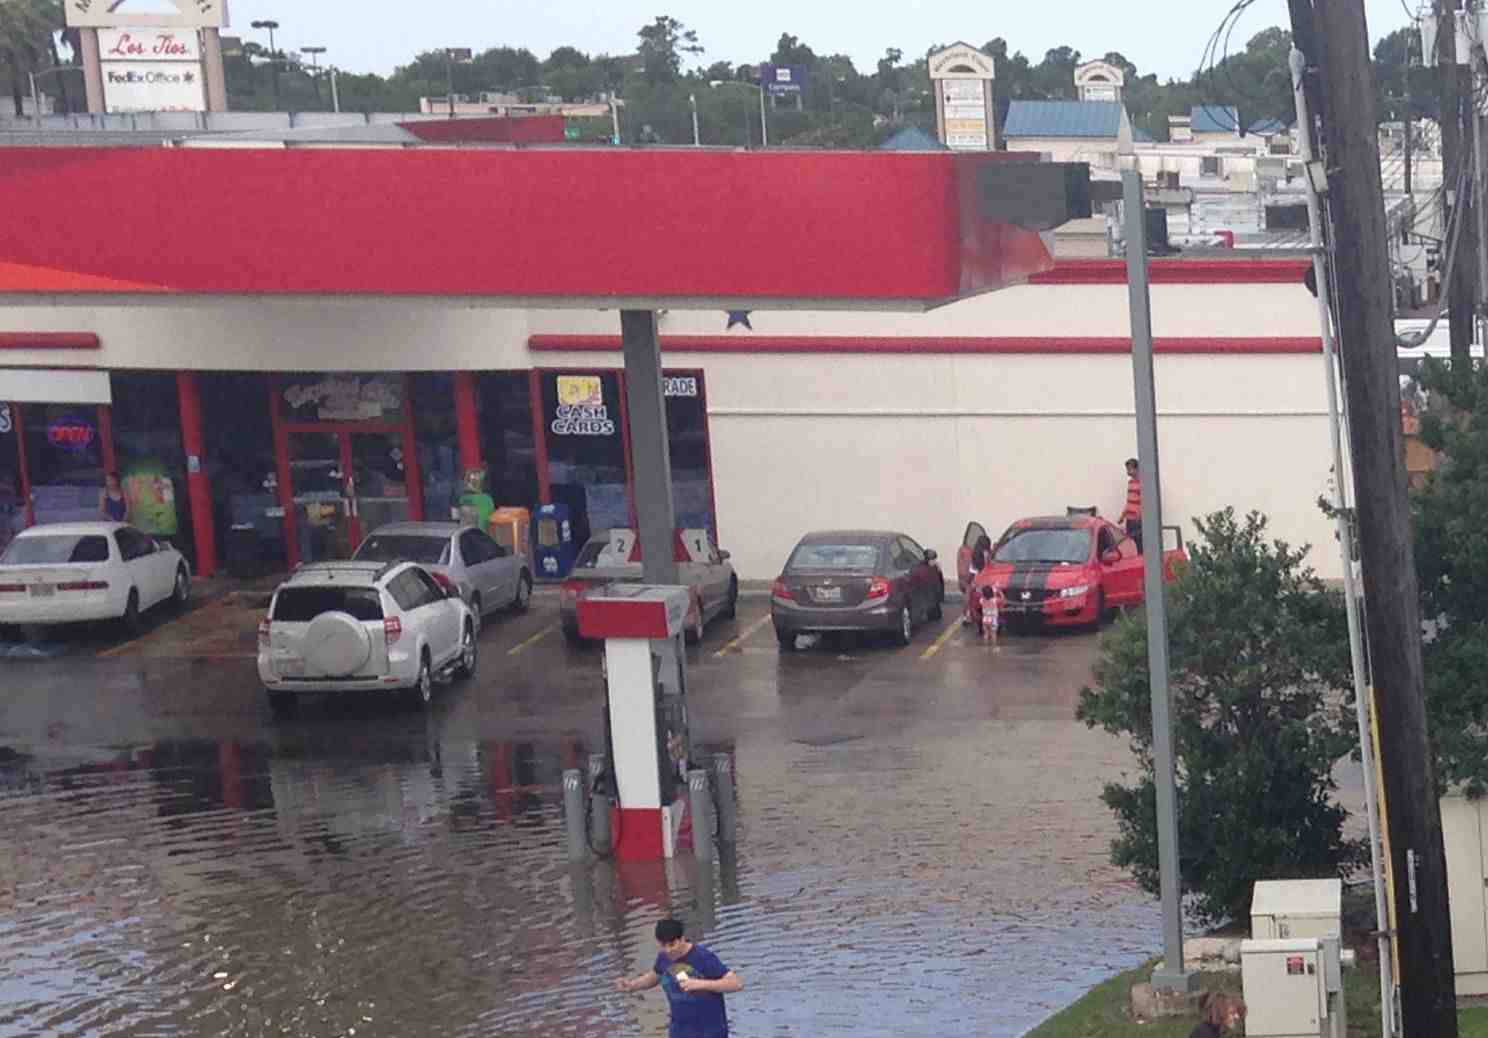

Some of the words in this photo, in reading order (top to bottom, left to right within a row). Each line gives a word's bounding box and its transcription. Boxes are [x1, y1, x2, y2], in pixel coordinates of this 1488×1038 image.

[109, 33, 145, 55] Los
[108, 71, 144, 83] FedEx
[145, 71, 180, 83] Office
[556, 405, 607, 420] CASH
[551, 419, 614, 435] CARDS
[616, 538, 625, 553] 2
[694, 538, 702, 553] 1
